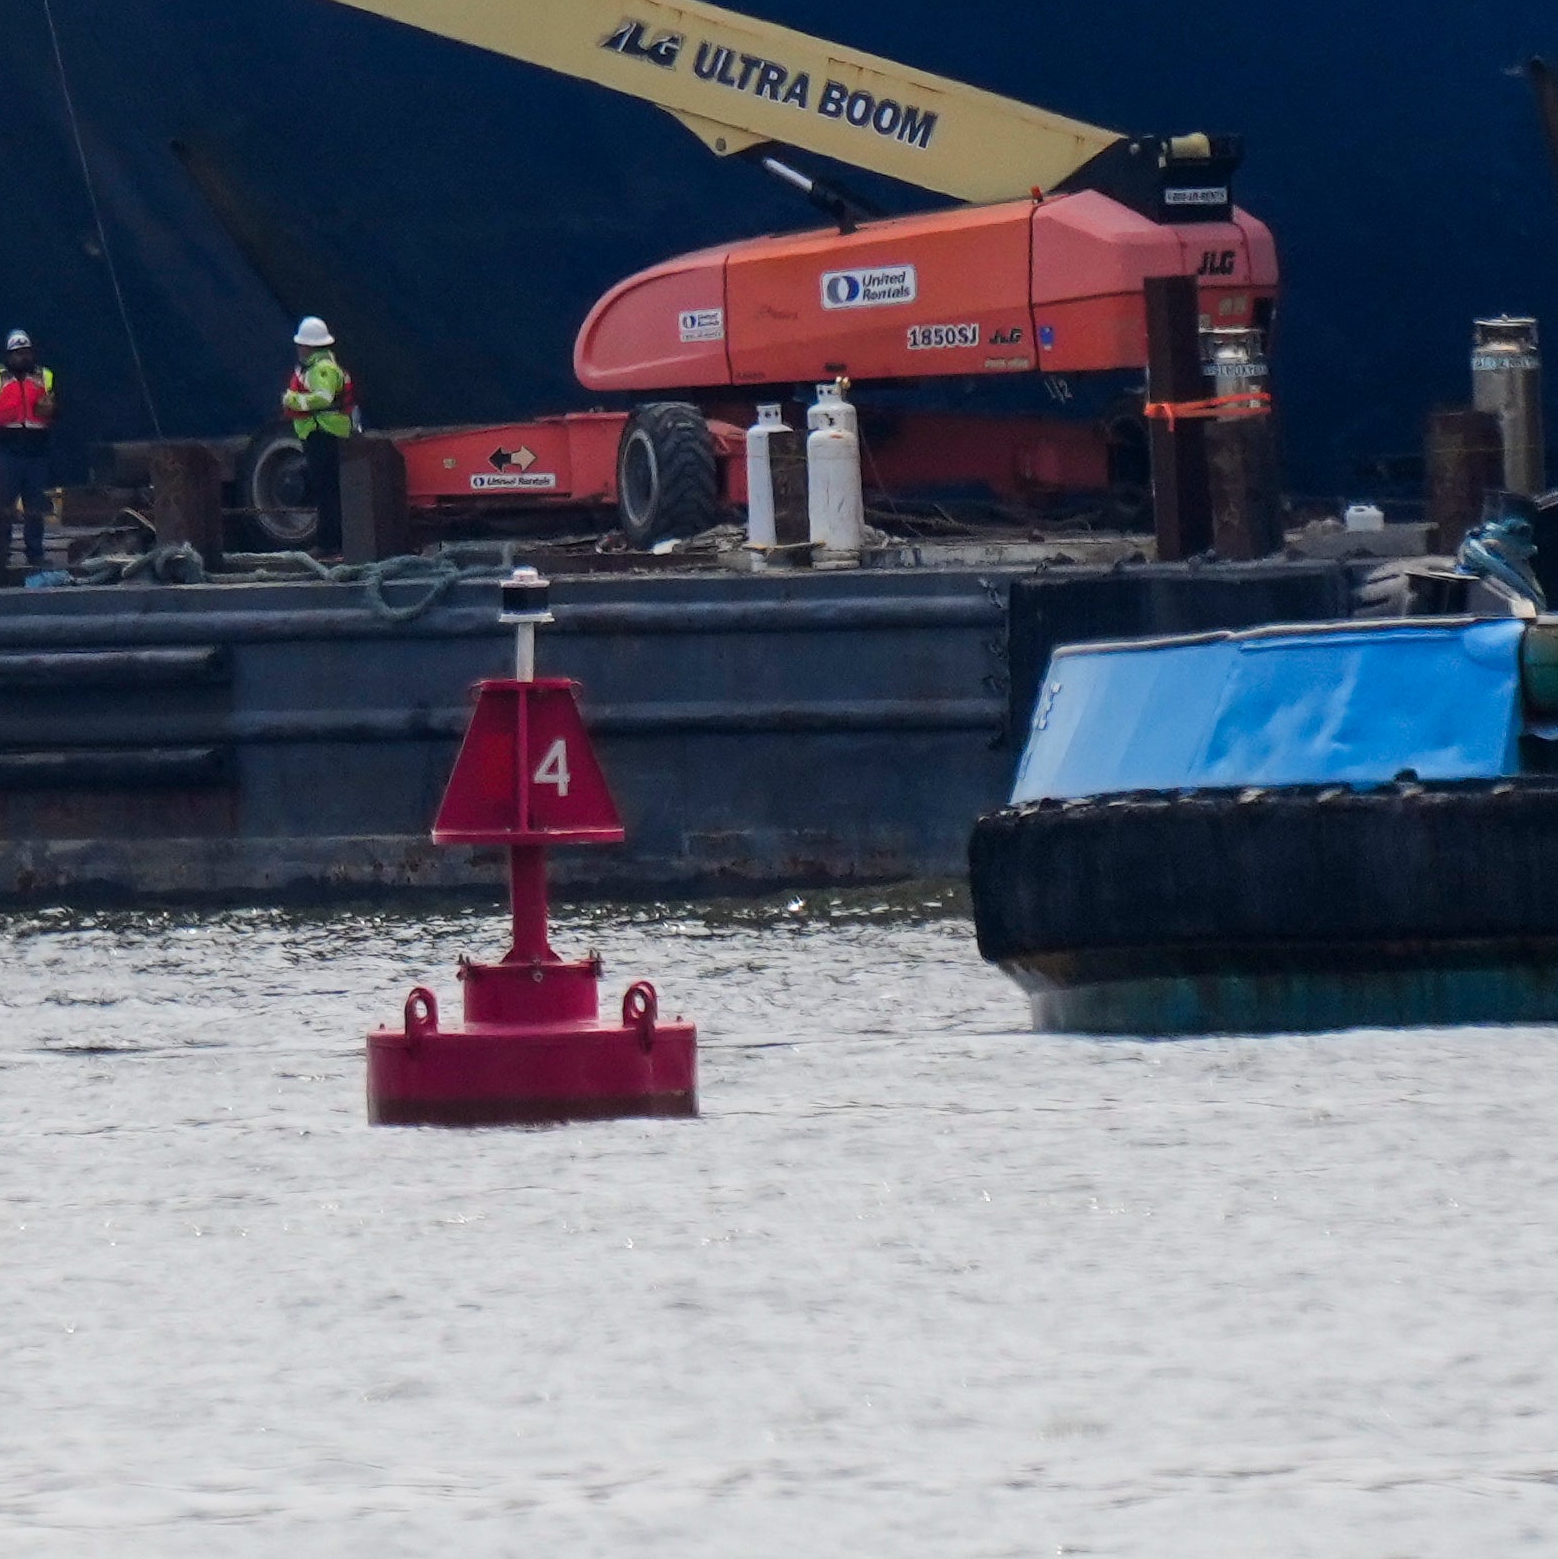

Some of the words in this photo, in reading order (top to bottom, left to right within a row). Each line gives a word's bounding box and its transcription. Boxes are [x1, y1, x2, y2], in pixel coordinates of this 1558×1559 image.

[691, 42, 811, 110] ULTRA
[817, 79, 939, 151] BOOM
[1197, 250, 1236, 275] JLG
[862, 271, 907, 287] United
[863, 286, 912, 301] Rentals
[908, 325, 979, 349] 1850SJ
[534, 738, 571, 797] 4
